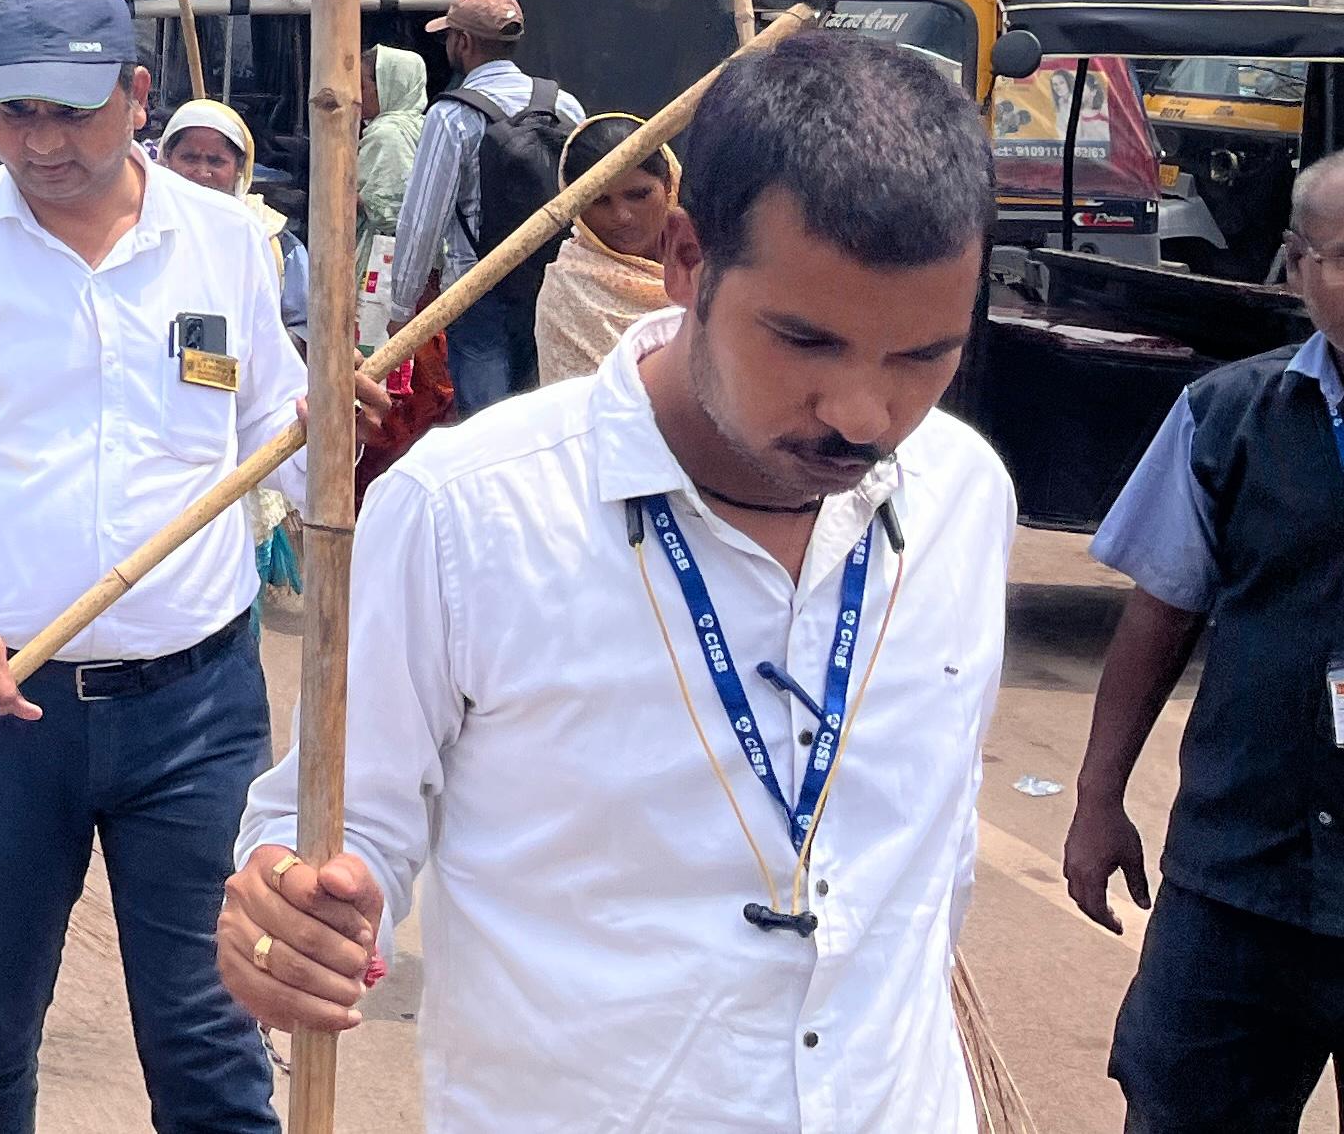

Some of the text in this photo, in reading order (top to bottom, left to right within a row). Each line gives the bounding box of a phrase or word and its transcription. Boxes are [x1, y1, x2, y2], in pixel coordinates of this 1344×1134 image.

[663, 532, 691, 572] CISB
[704, 631, 730, 674] CISB
[834, 627, 853, 668] CISB
[745, 736, 768, 778] CISB
[814, 730, 835, 771] CISB
